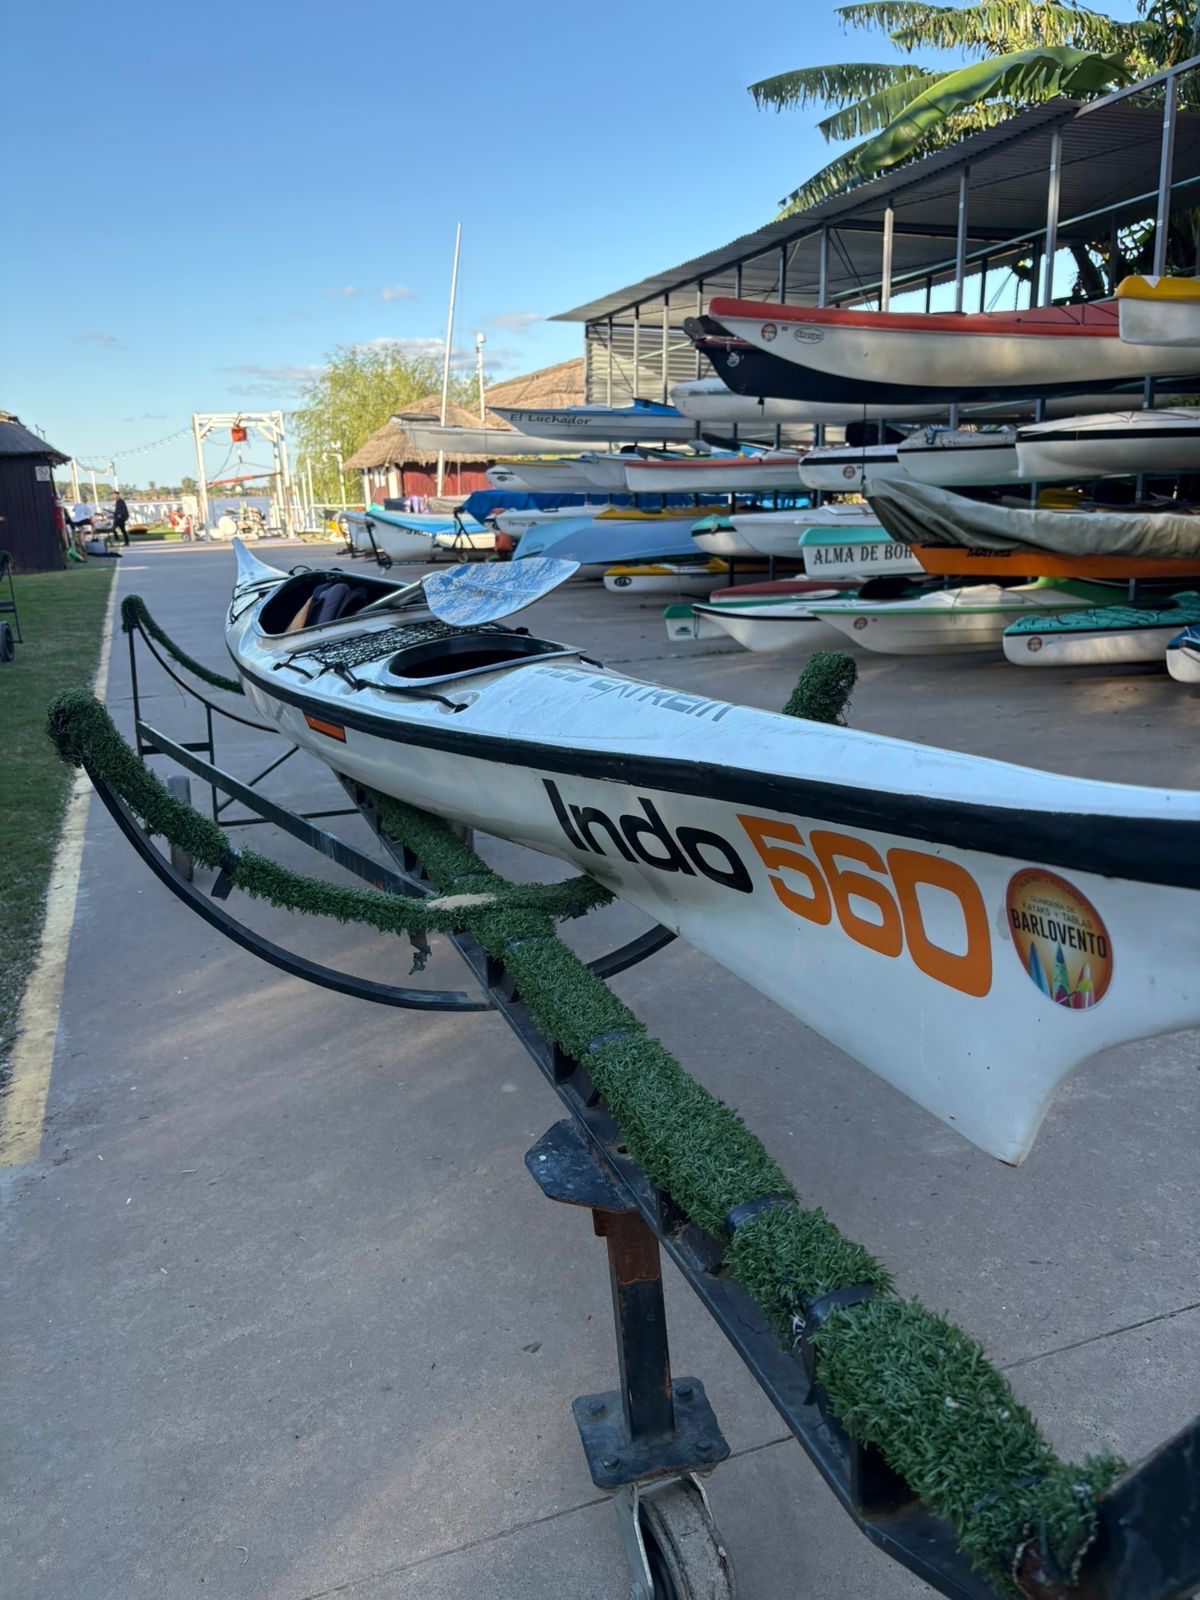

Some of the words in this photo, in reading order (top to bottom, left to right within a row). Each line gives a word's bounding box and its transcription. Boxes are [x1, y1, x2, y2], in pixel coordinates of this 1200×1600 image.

[510, 412, 524, 422] El
[528, 413, 592, 425] Luchador
[813, 547, 854, 565] ALMA
[860, 545, 878, 561] DE
[541, 778, 754, 894] Indo
[735, 813, 993, 998] 560
[1022, 901, 1050, 916] KAYAKS
[1062, 912, 1092, 928] TABLAS
[1011, 908, 1108, 959] BARLOVENTO
